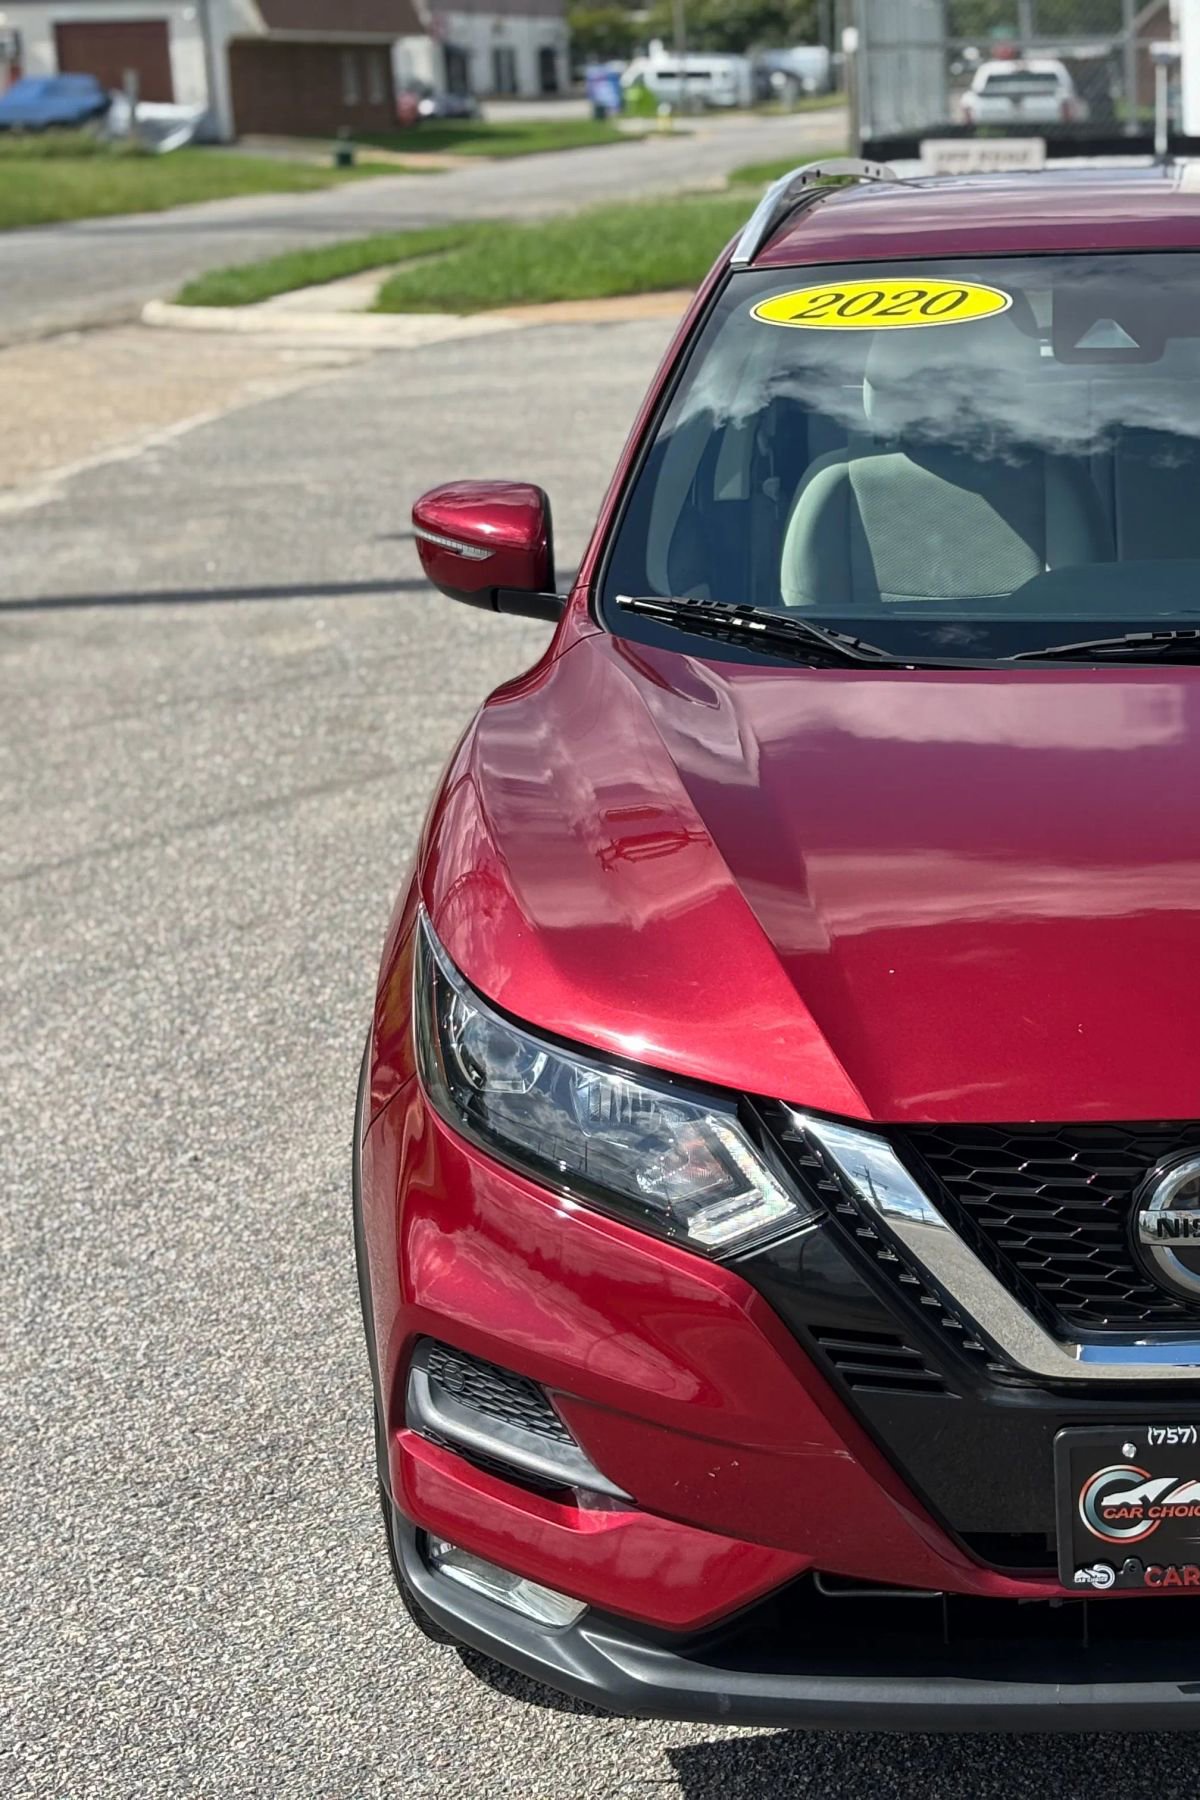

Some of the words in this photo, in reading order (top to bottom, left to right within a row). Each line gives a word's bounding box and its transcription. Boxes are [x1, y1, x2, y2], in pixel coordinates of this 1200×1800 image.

[788, 289, 969, 320] 2020
[1147, 1425, 1198, 1446] (757)
[1102, 1506, 1144, 1520] CAR
[1143, 1564, 1200, 1588] CAR
